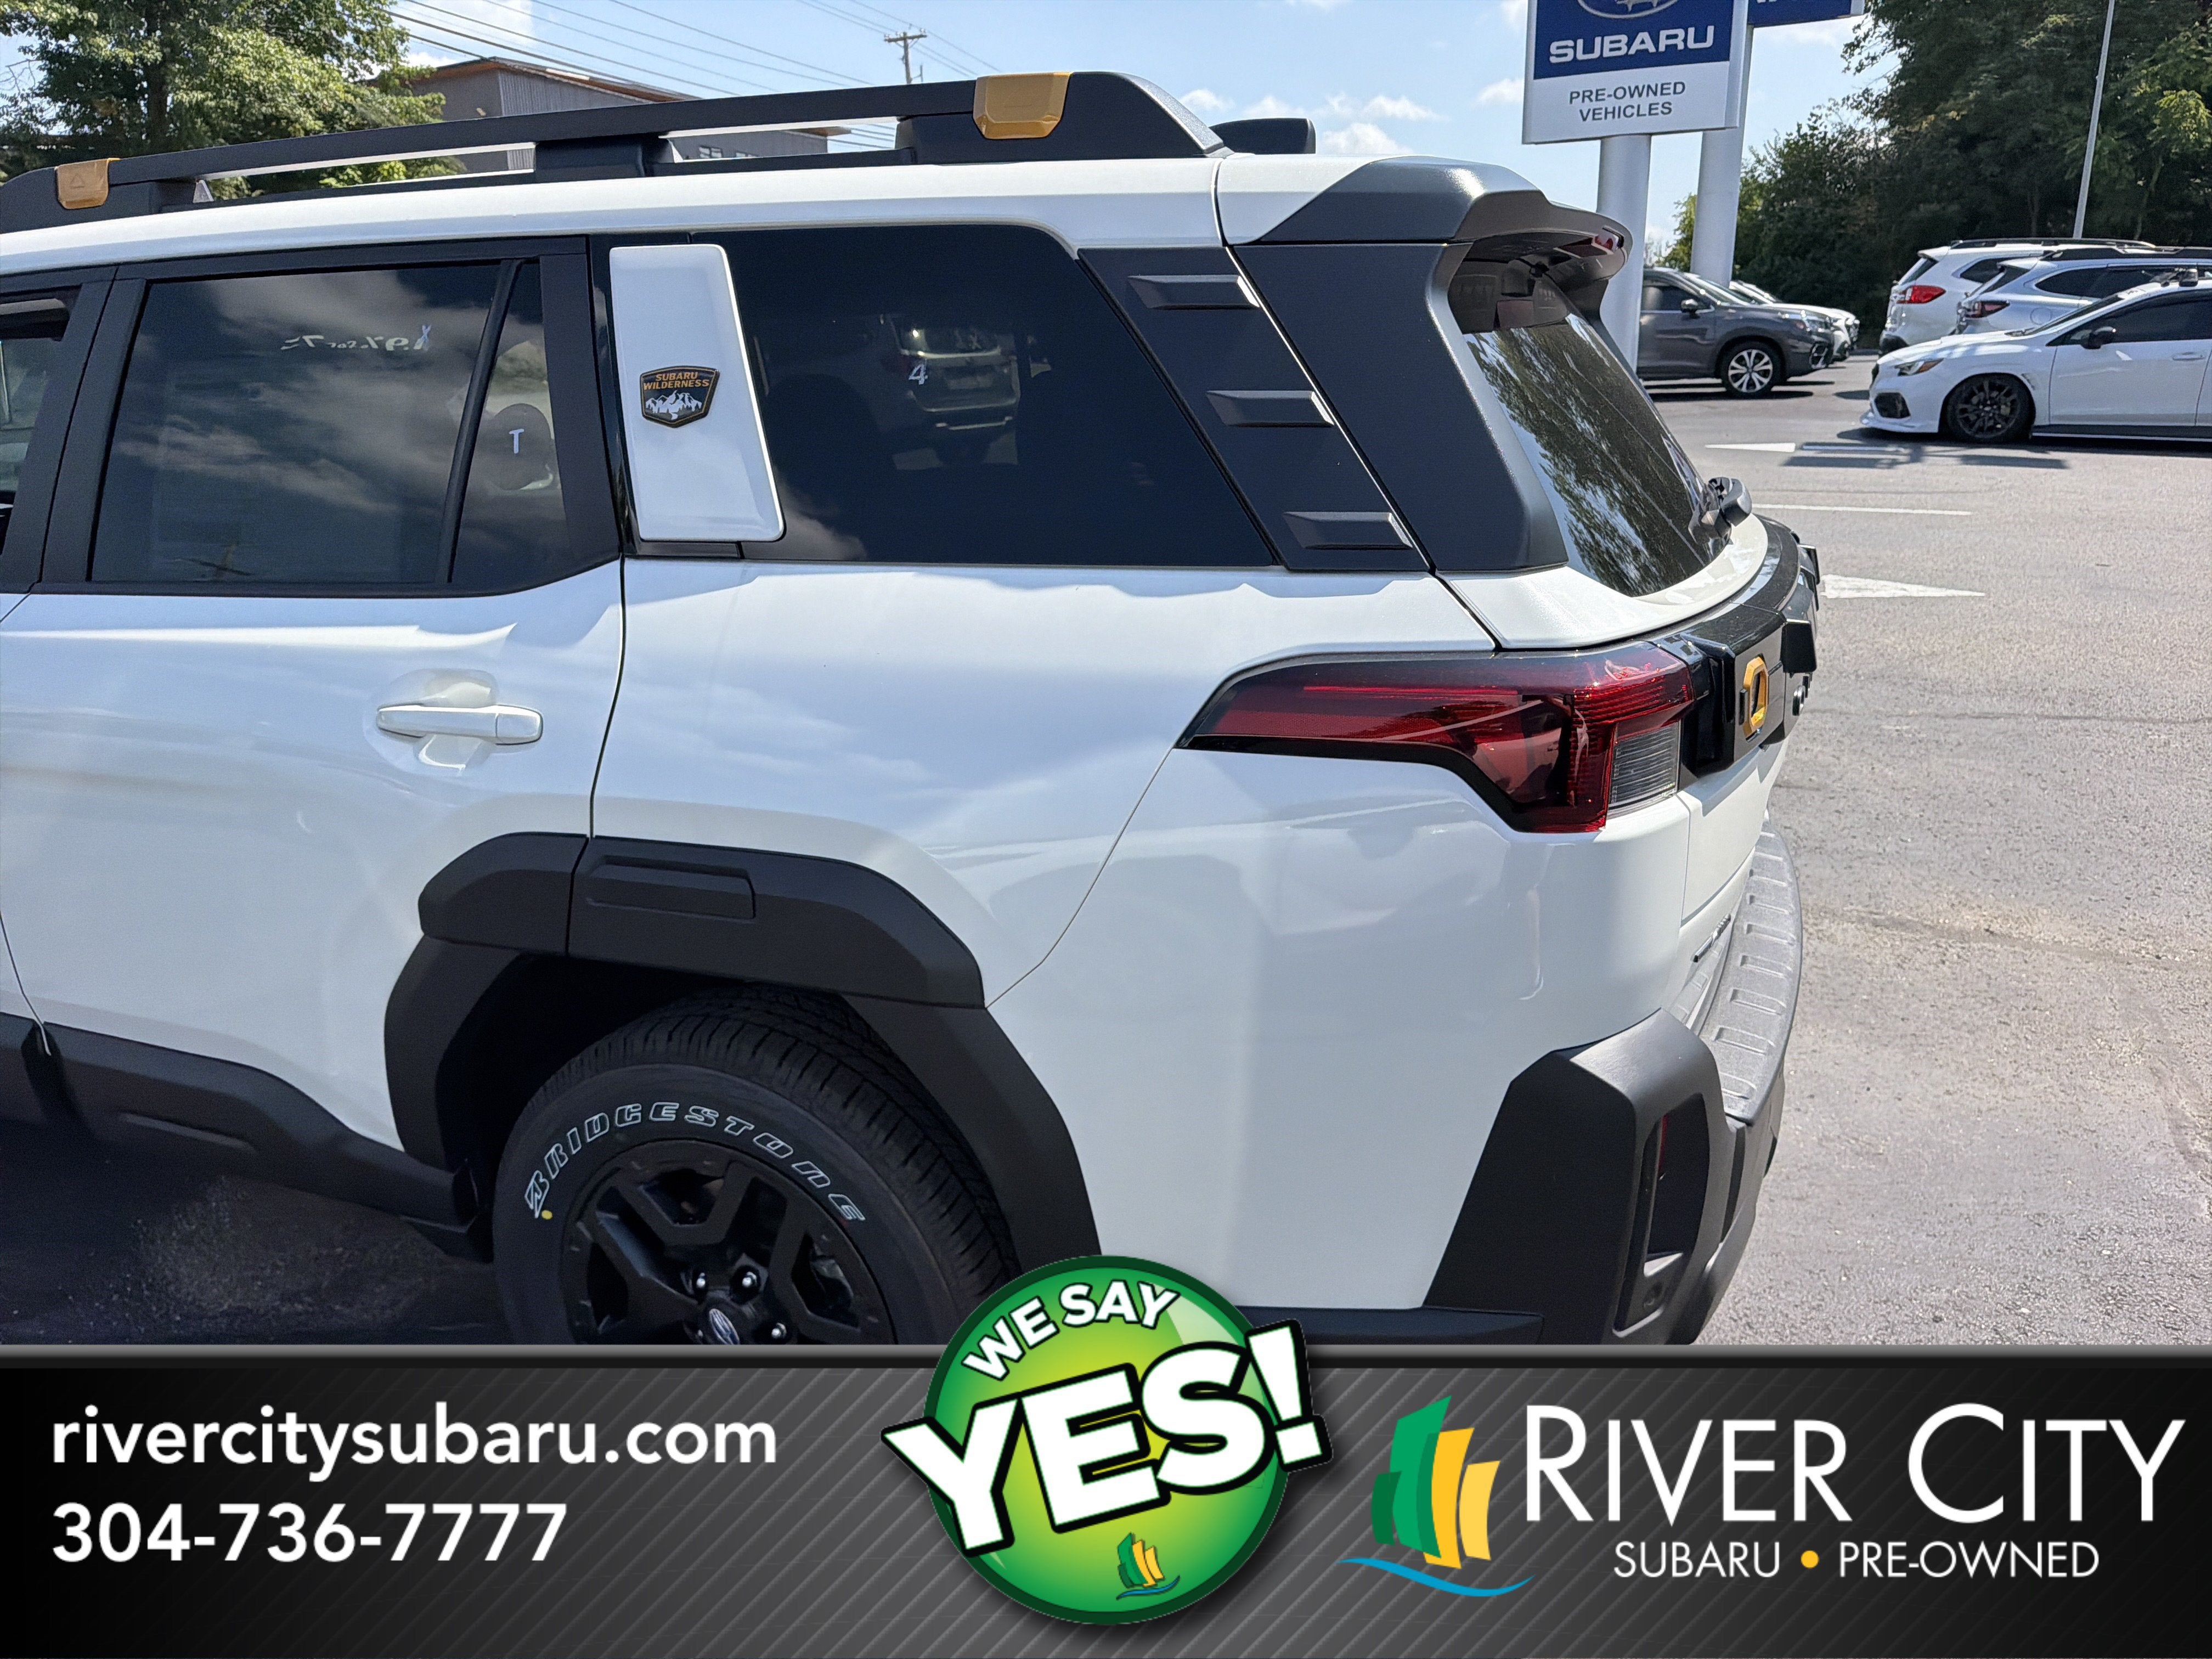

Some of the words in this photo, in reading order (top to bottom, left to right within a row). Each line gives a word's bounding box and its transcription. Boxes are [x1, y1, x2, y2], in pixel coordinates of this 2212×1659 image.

[1549, 25, 1714, 64] SUBARU
[1569, 81, 1686, 105] PRE-OWNED
[1579, 101, 1673, 122] VEHICLES
[644, 379, 710, 390] WILDERNESS
[656, 371, 698, 382] SUBARU
[908, 363, 928, 385] 4
[524, 1102, 866, 1221] BRIDGESTONE
